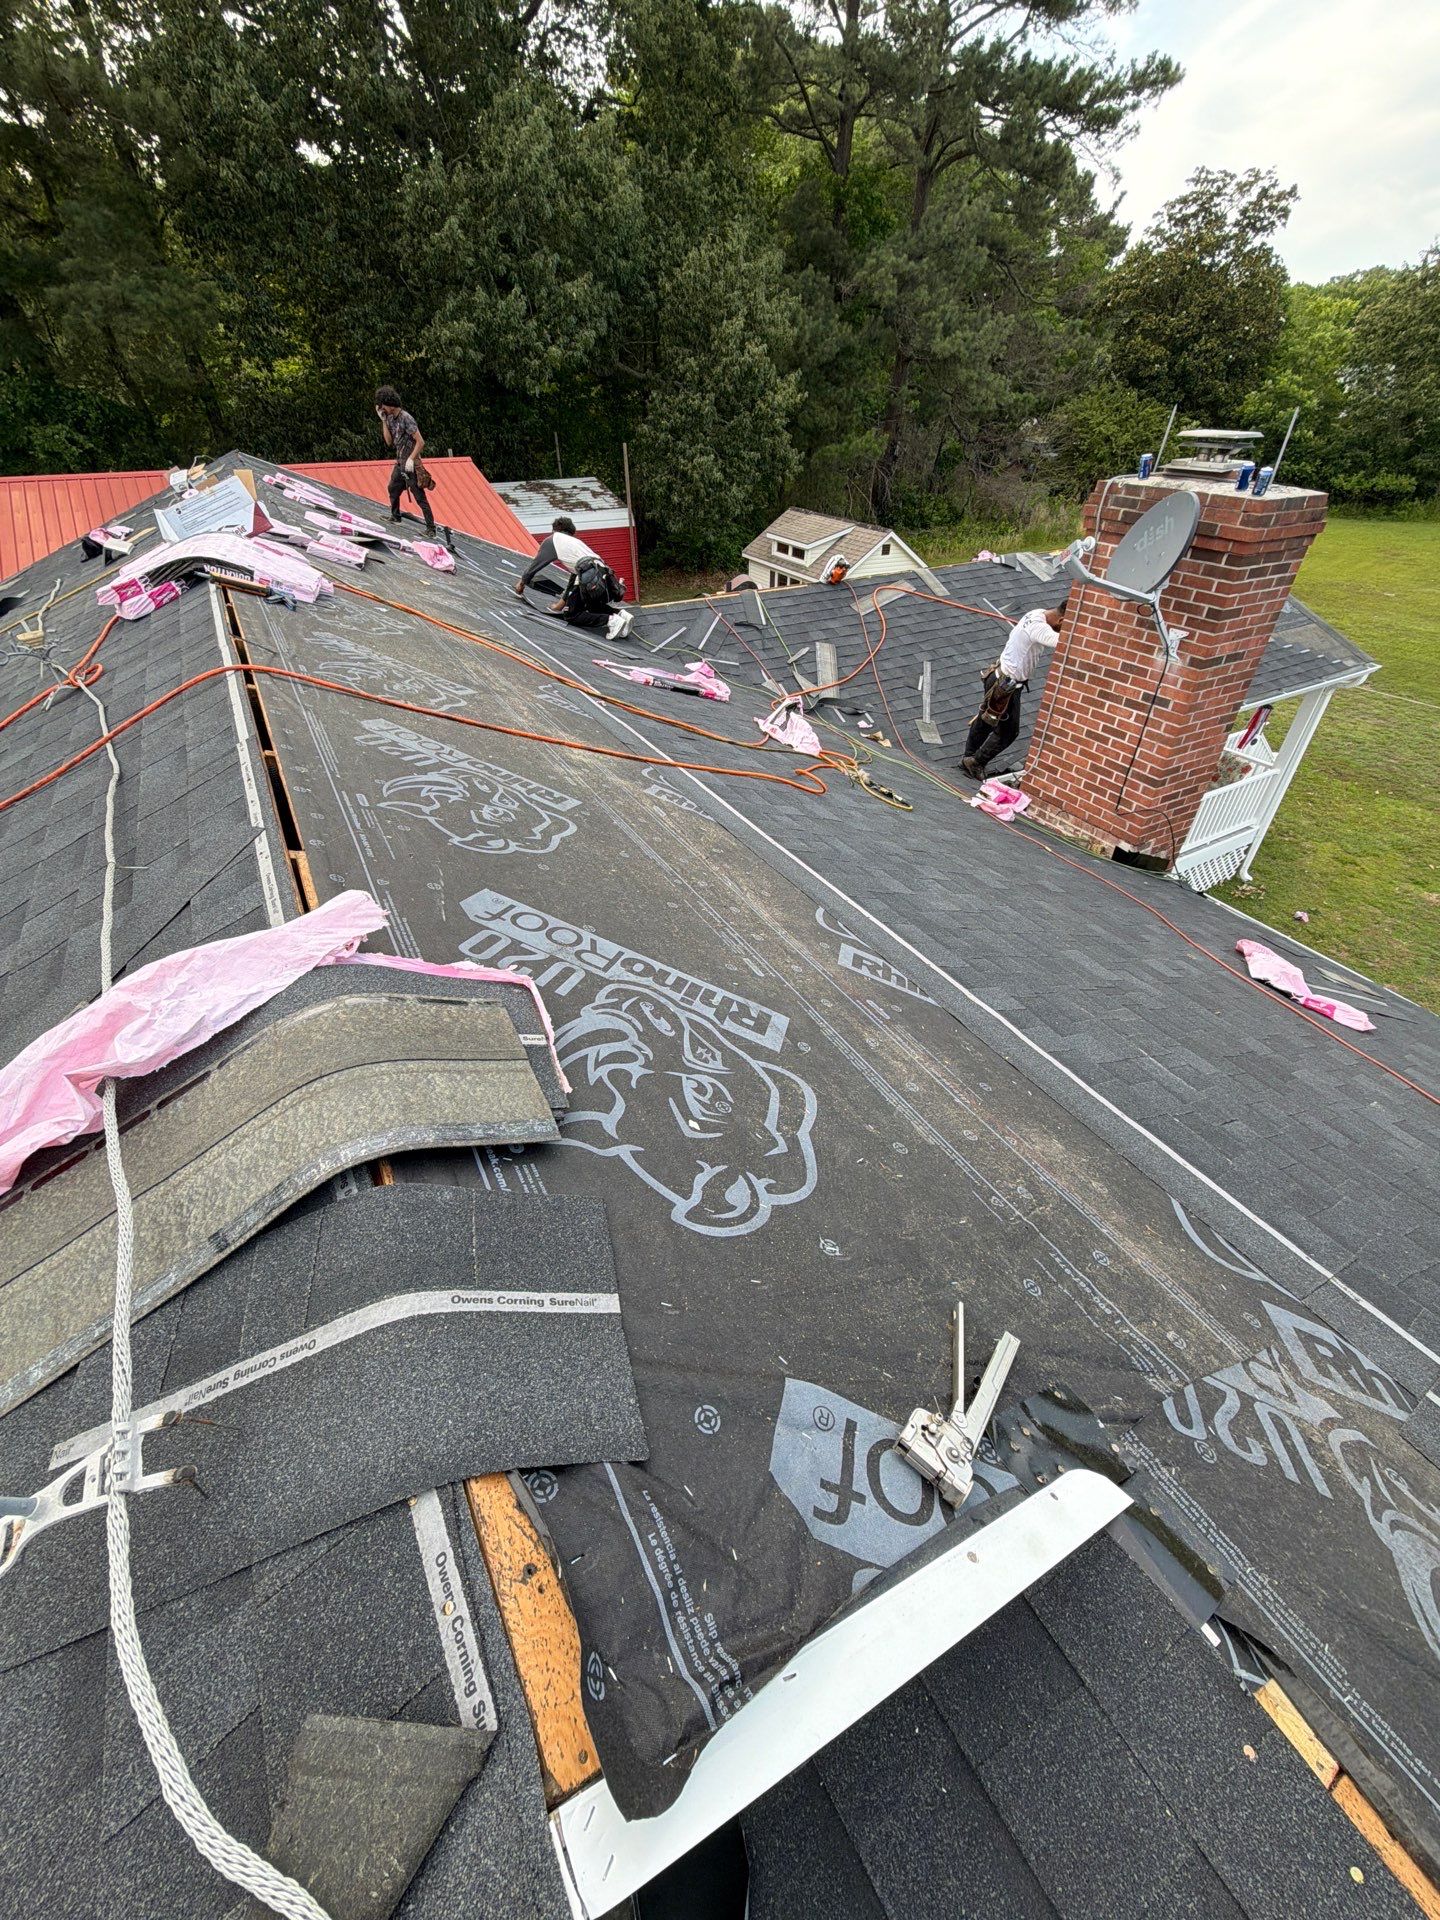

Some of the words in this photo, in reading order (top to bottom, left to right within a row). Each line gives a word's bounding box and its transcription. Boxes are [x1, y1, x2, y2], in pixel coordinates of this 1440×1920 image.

[451, 1295, 494, 1304] Owens
[497, 1296, 545, 1308] Corning
[279, 1338, 317, 1362] Owens
[233, 1357, 277, 1382] Corning
[649, 1502, 677, 1561] resistencia
[678, 1577, 695, 1615] desliz
[690, 1616, 710, 1657] puede
[451, 1614, 478, 1699] Corning
